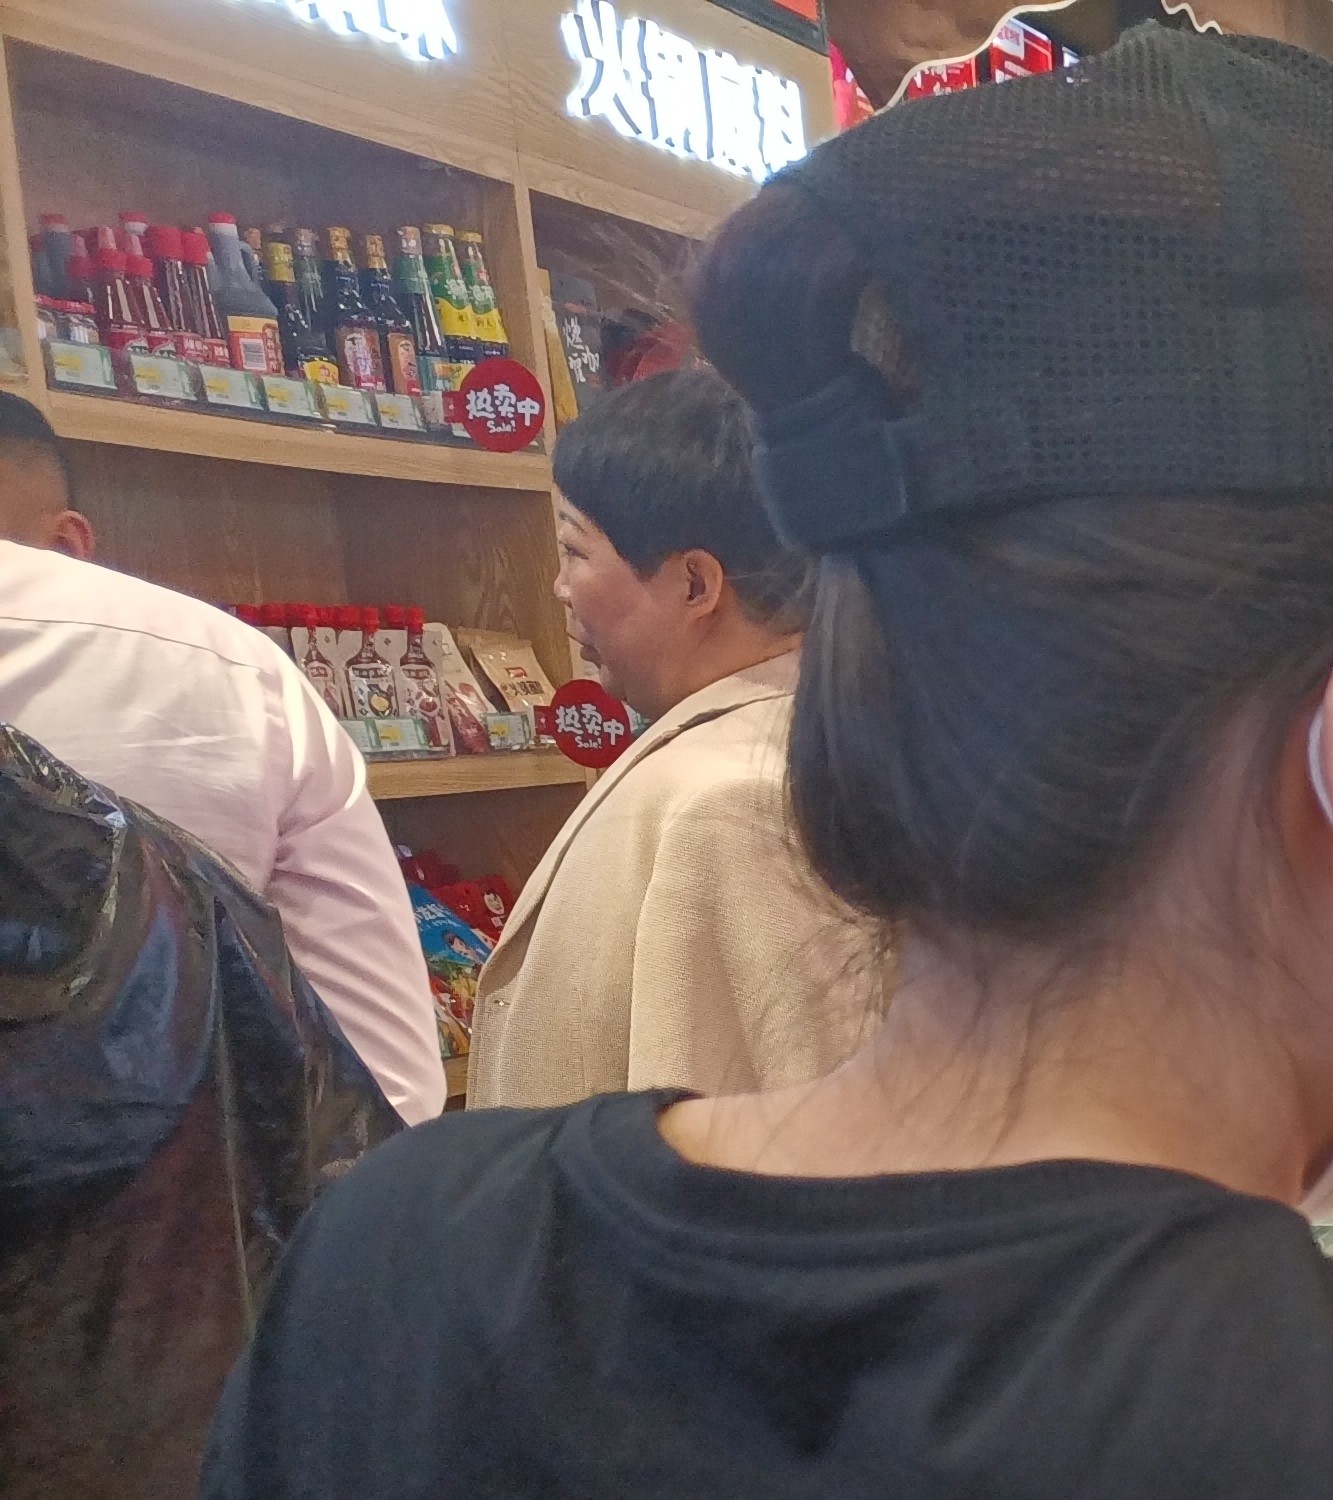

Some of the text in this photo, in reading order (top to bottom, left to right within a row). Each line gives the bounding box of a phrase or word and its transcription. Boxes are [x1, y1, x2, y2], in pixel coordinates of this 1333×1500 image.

[466, 384, 540, 426] 热卖中
[555, 703, 625, 745] 热卖中
